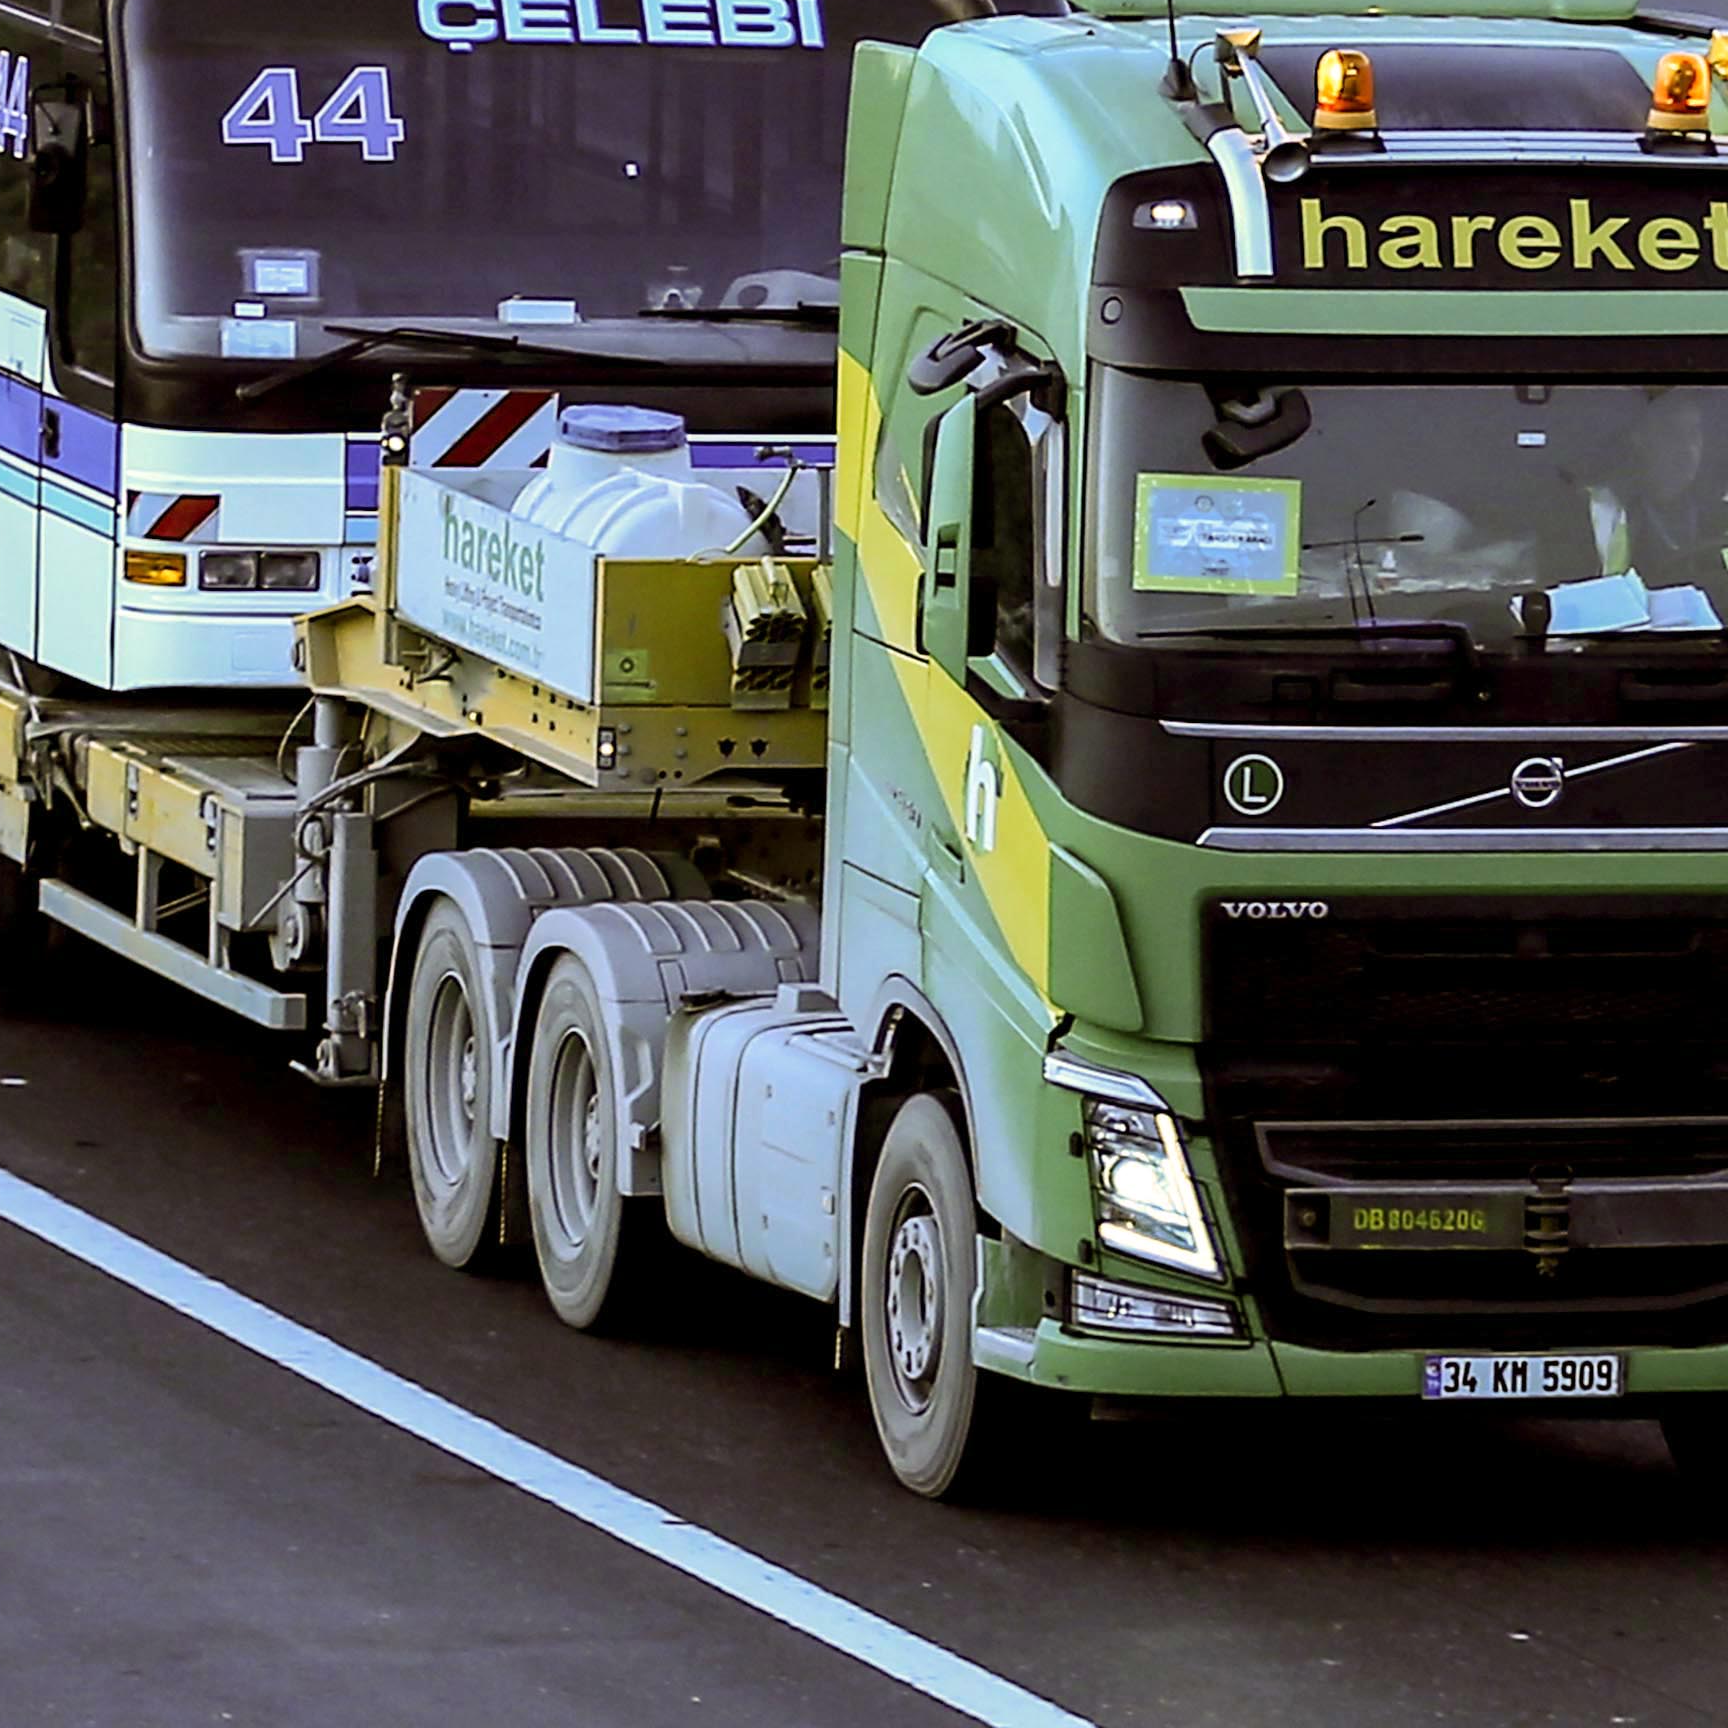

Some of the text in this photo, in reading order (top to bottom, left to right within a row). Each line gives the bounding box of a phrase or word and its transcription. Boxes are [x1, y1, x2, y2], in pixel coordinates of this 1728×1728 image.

[221, 66, 406, 163] 44
[443, 493, 546, 603] hareket
[965, 723, 1000, 852] h
[1242, 766, 1268, 803] L
[1219, 901, 1329, 920] VOLVO
[1443, 1359, 1613, 1393] 34 KM 5909
